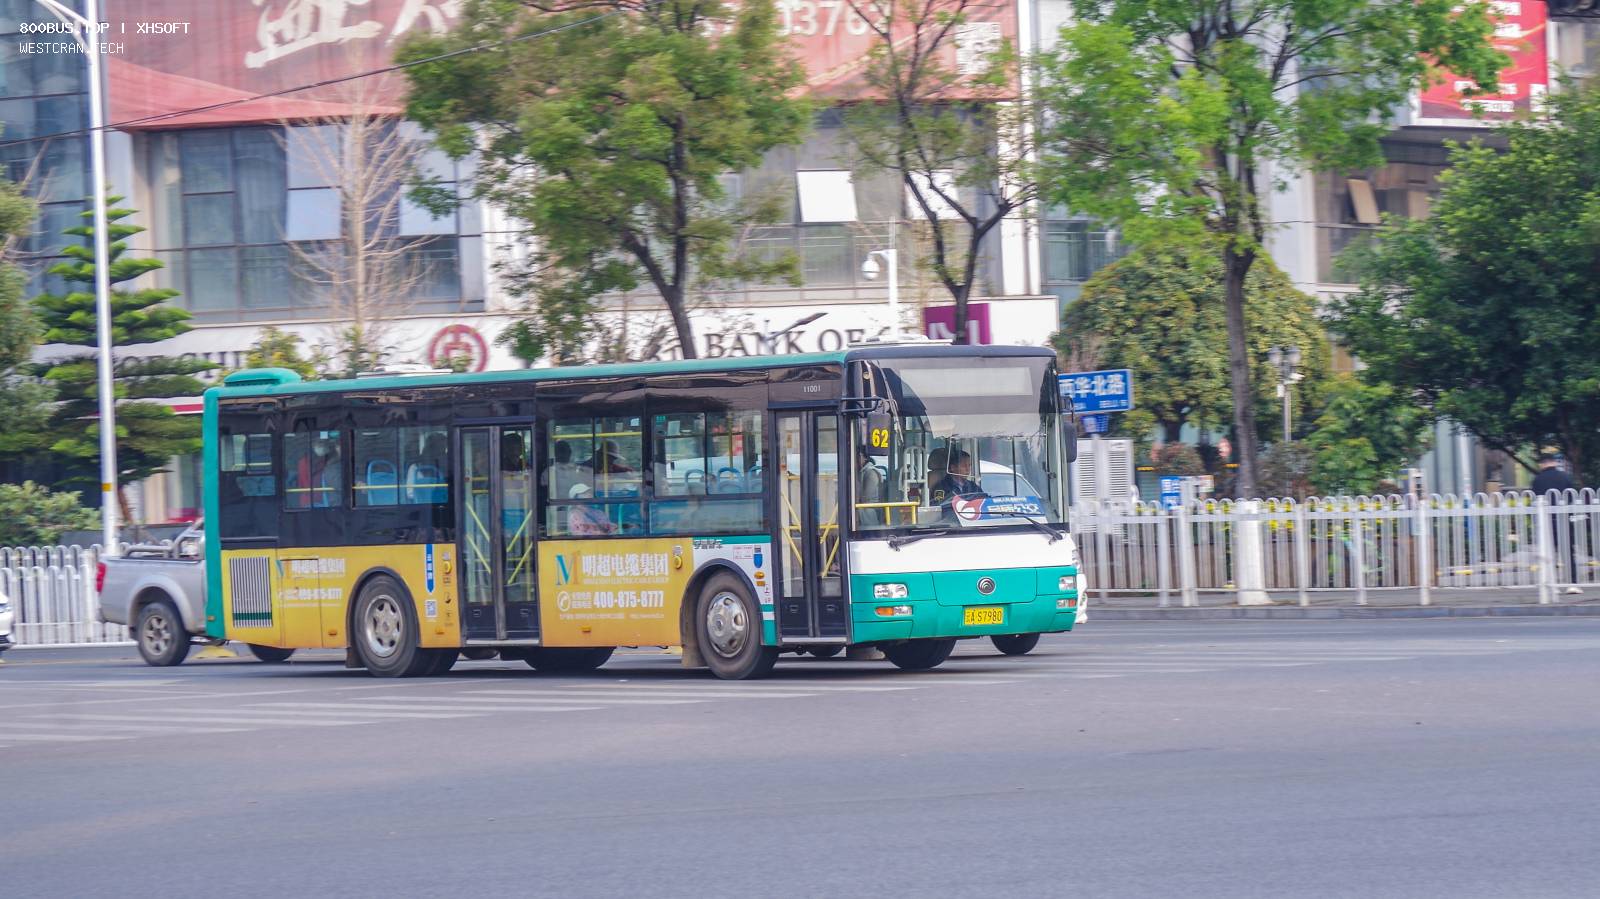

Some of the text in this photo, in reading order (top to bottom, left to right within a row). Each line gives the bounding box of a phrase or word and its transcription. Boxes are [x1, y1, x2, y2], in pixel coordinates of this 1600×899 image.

[704, 330, 805, 359] BANK
[803, 384, 821, 393] 11001
[871, 428, 889, 448] 62
[593, 590, 665, 608] 400-875-8777
